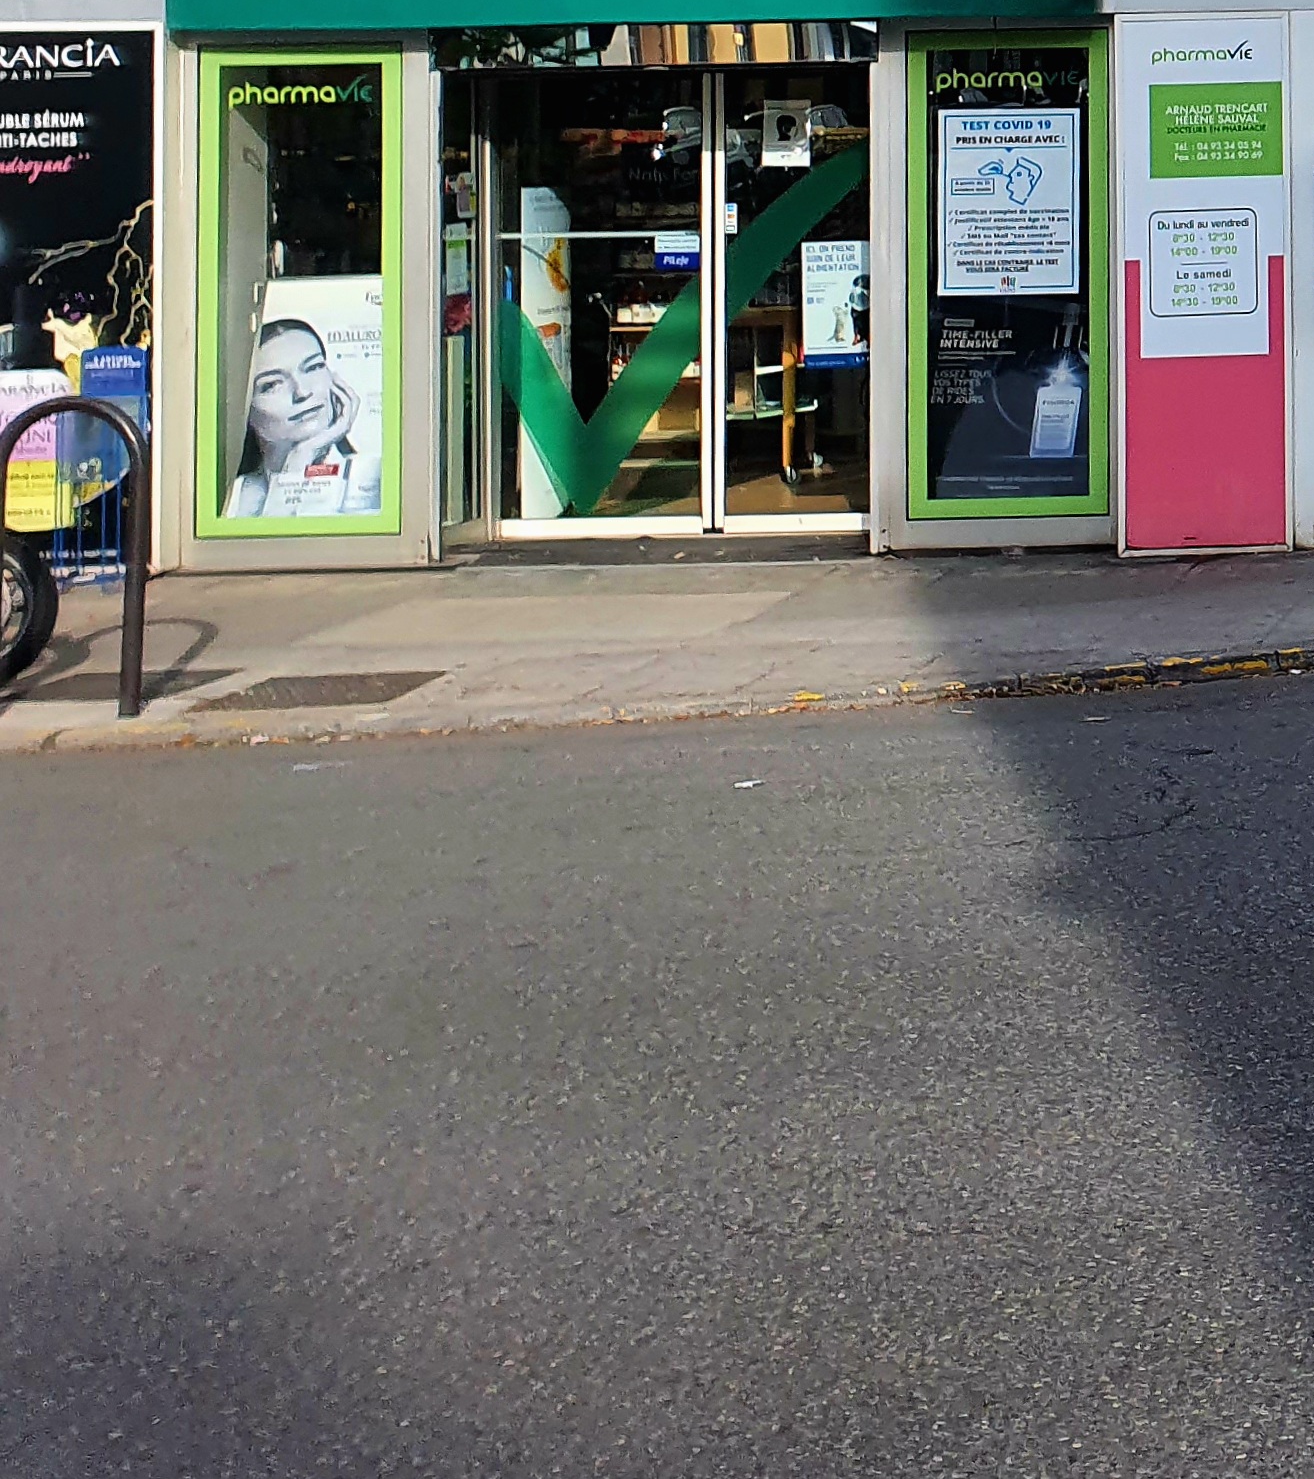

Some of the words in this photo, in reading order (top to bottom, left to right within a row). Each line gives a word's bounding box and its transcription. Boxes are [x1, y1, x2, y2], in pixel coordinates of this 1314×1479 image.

[1165, 105, 1212, 115] ARNAUD
[1214, 103, 1268, 113] TRENCART
[1217, 114, 1258, 124] SAUVAL
[962, 121, 990, 130] TEST
[994, 120, 1033, 130] COVID
[1038, 120, 1051, 129] 19
[1167, 126, 1207, 134] DOCTEURS
[1222, 124, 1266, 133] PHARMACIE
[956, 136, 977, 144] PRIS
[979, 136, 992, 144] EN
[994, 135, 1032, 144] CHARGE
[1034, 135, 1060, 143] AVEC
[1157, 221, 1170, 230] Du
[1173, 220, 1194, 229] lundi
[1211, 218, 1249, 228] vendredi
[1176, 271, 1189, 279] Le
[1194, 269, 1231, 278] samedi
